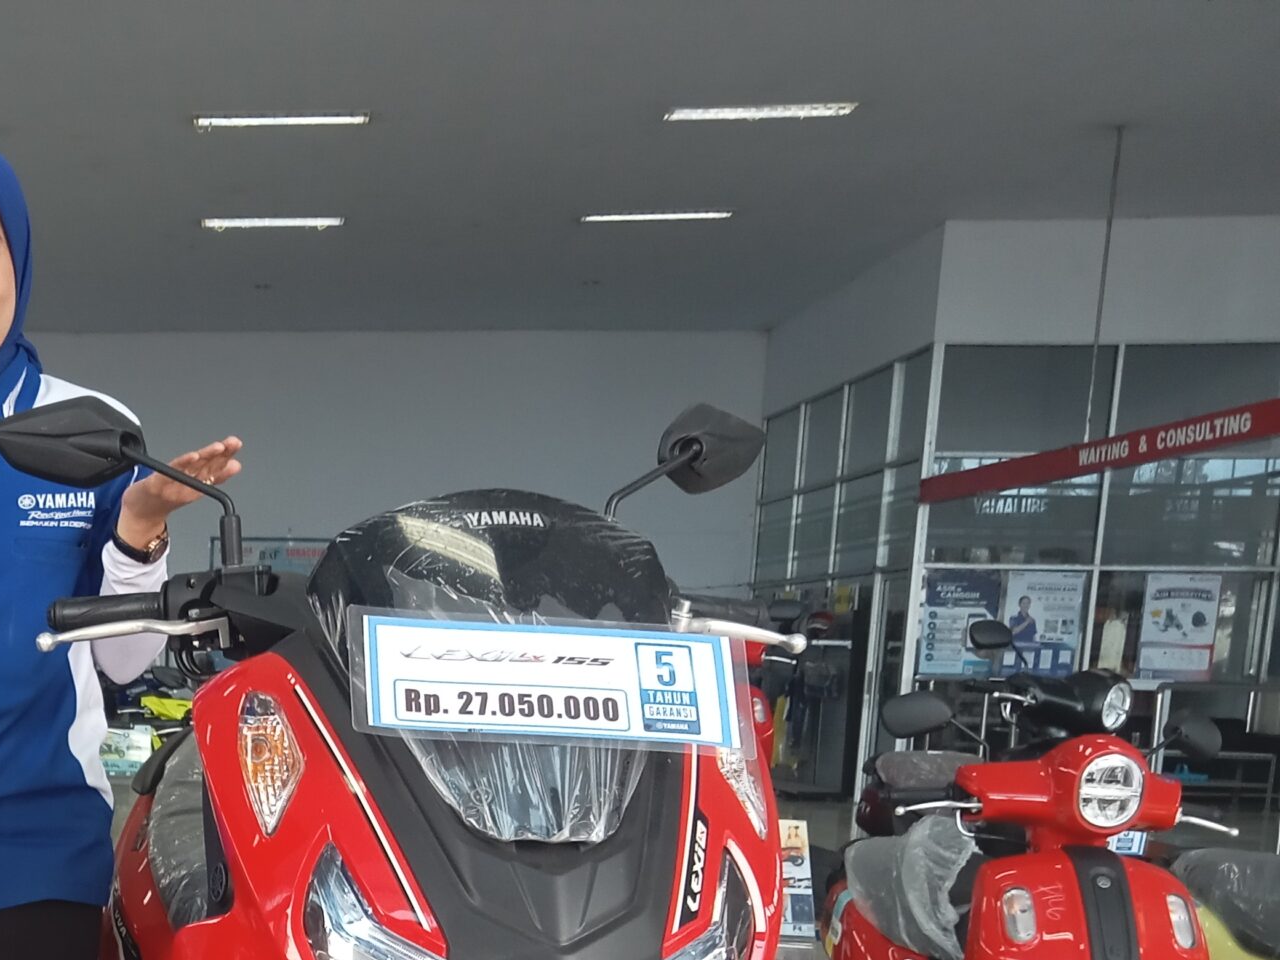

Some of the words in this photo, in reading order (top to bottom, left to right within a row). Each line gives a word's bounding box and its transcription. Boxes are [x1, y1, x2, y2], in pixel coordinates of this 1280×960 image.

[1078, 440, 1129, 466] WAITING
[1138, 434, 1147, 453] &
[1156, 412, 1252, 450] CONSULTING
[35, 491, 96, 508] YAMAHA
[468, 511, 545, 527] YAMAHA
[552, 656, 614, 666] 155
[655, 651, 676, 686] 5
[404, 688, 449, 716] Rp.
[457, 691, 620, 722] 27.050.000
[647, 690, 691, 705] TAHUN
[648, 706, 693, 719] GARANSI
